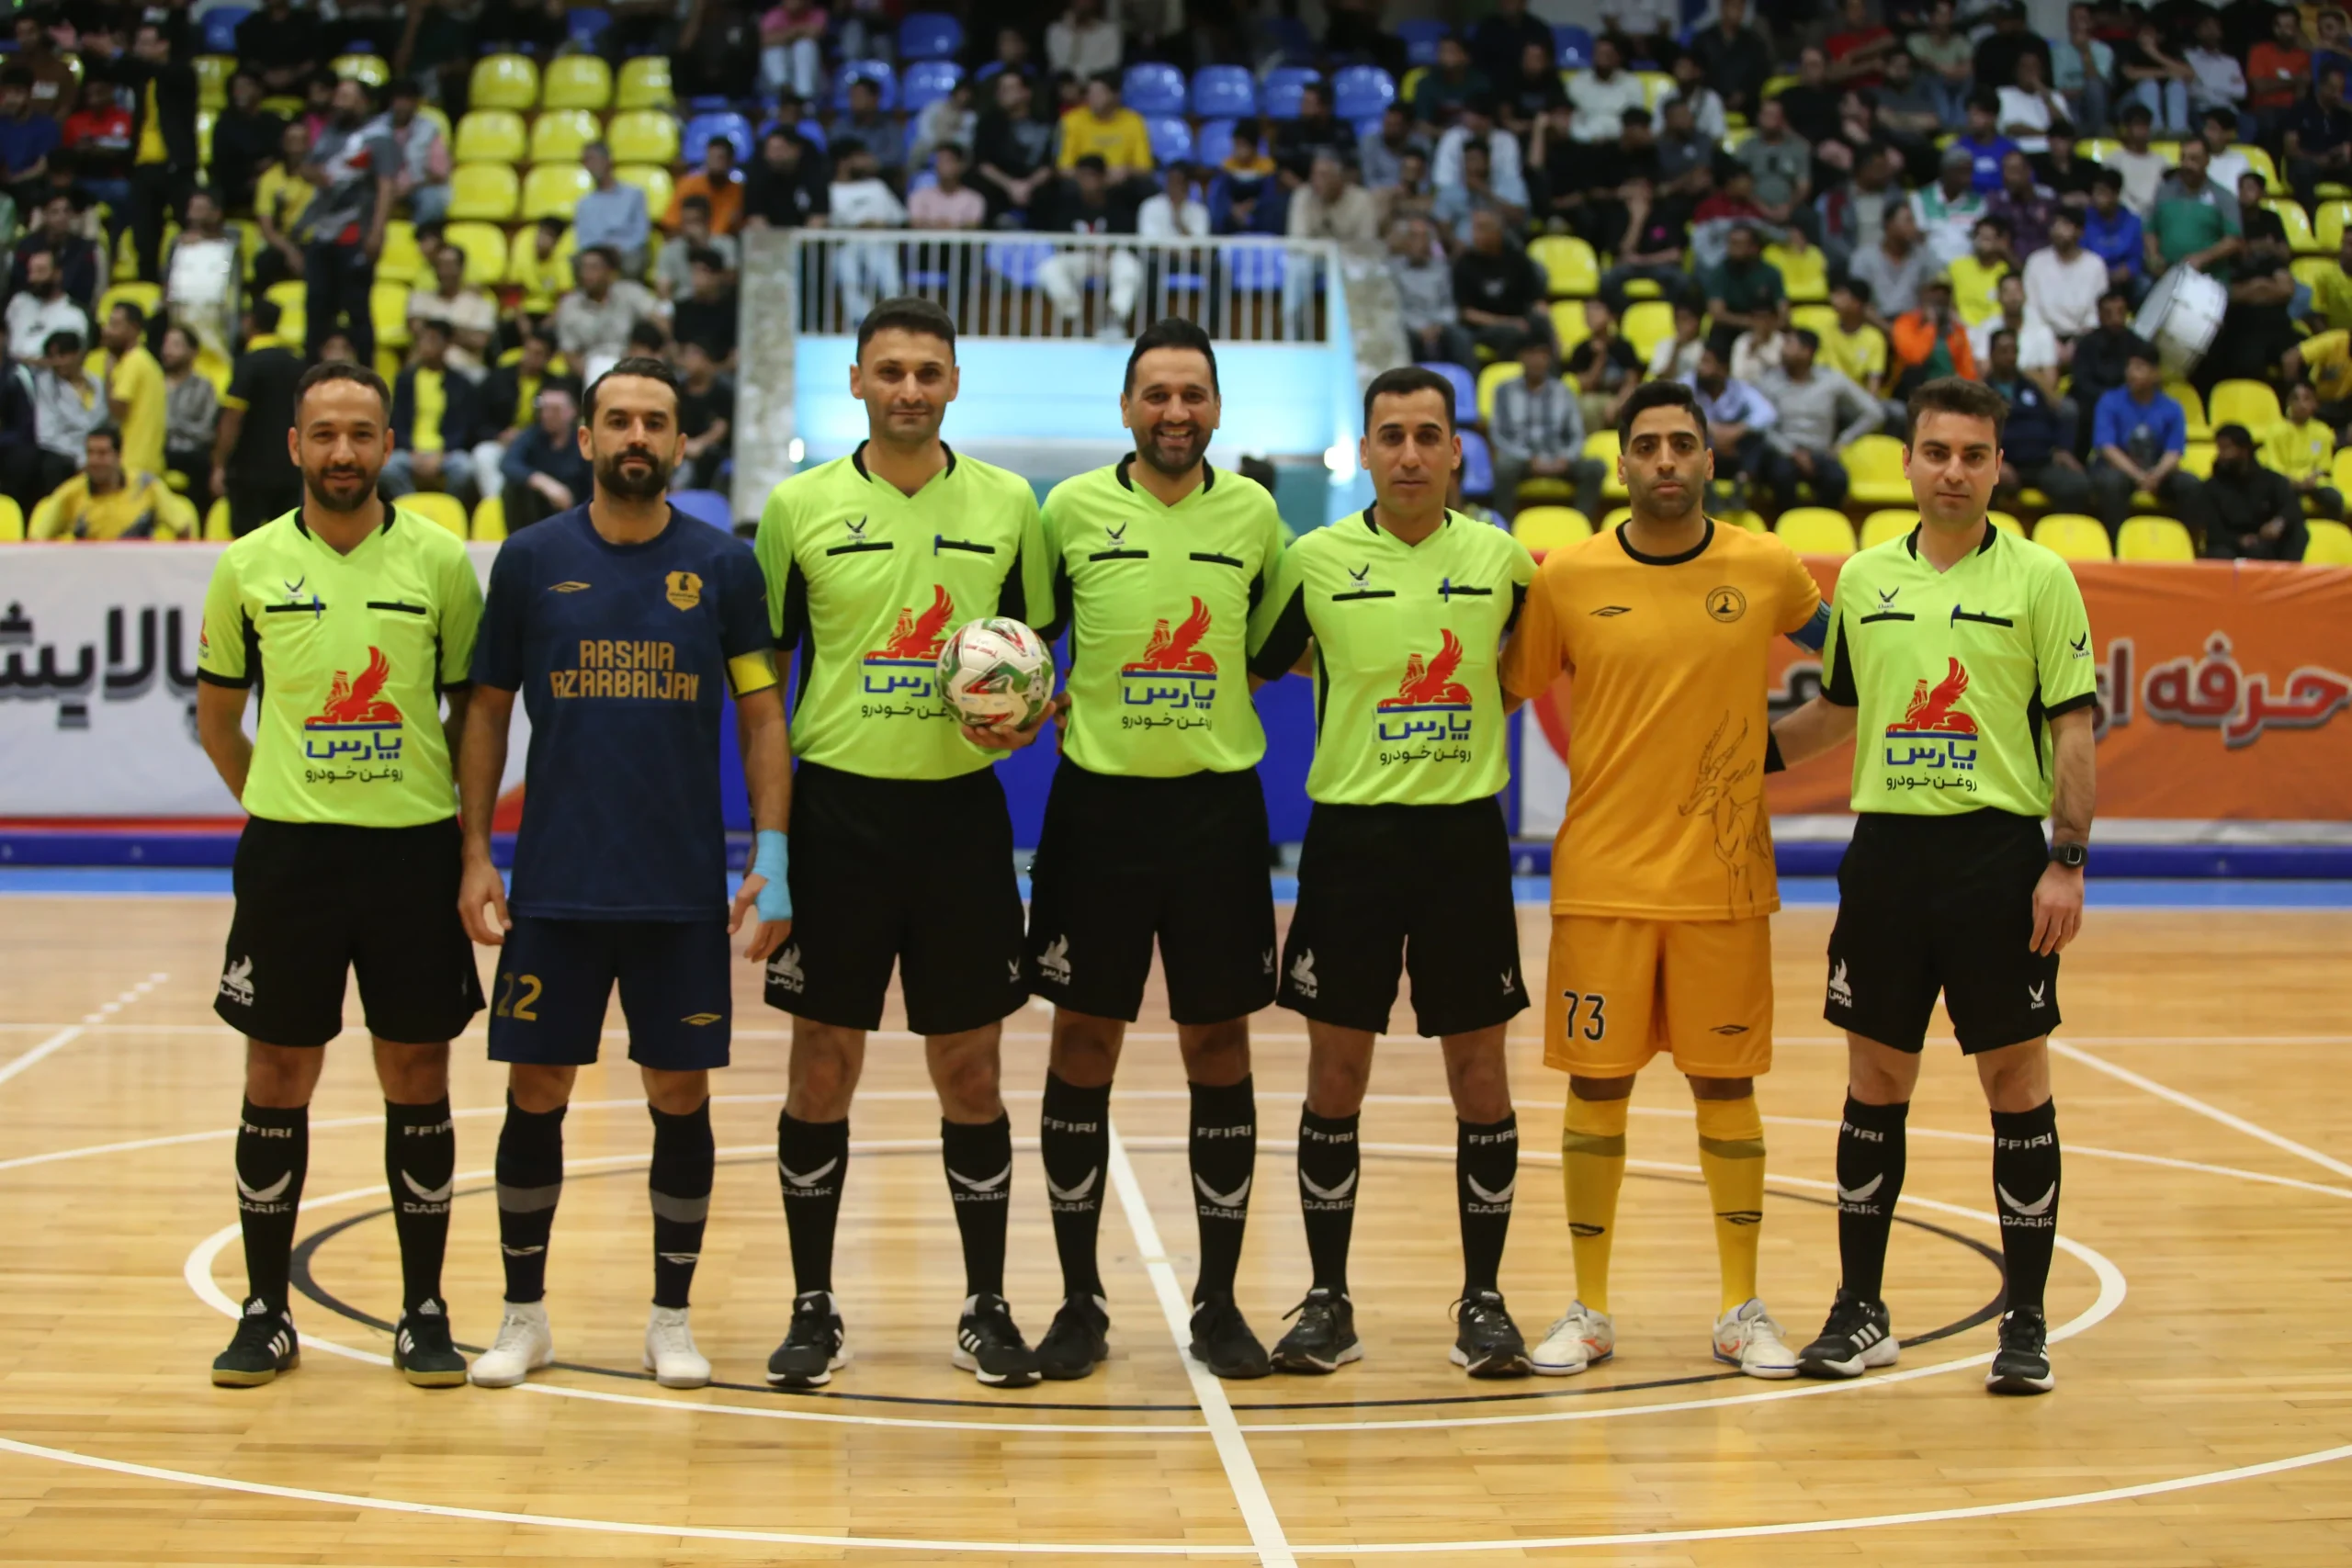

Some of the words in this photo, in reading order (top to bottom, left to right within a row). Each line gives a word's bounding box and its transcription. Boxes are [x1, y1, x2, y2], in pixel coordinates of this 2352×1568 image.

[580, 639, 674, 671] ARSHIA
[549, 670, 699, 701] AZARBAIJAN
[1125, 681, 1216, 709] پارس
[2142, 631, 2352, 750] حرفه
[861, 701, 915, 719] خودرو
[1122, 712, 1174, 731] خودرو
[1379, 713, 1472, 740] پارس
[306, 731, 402, 761] پارس
[1380, 745, 1432, 765] خودرو
[1434, 745, 1472, 763] روغن
[1886, 741, 1977, 770] پارس
[305, 764, 357, 784] خودرو
[359, 764, 403, 783] روغن
[1886, 772, 1931, 790] خودرو
[1933, 773, 1977, 792] روغن
[496, 972, 543, 1021] 22
[1563, 990, 1606, 1042] 73
[404, 1120, 452, 1136] FFIR
[1043, 1116, 1098, 1133] FFIRI
[1196, 1124, 1251, 1139] FFIRI
[1842, 1121, 1884, 1143] FIRI
[1302, 1126, 1353, 1144] FFIRI
[1997, 1132, 2053, 1150] FFIRI
[1838, 1201, 1881, 1215] ARIK
[2001, 1214, 2054, 1228] DARIK
